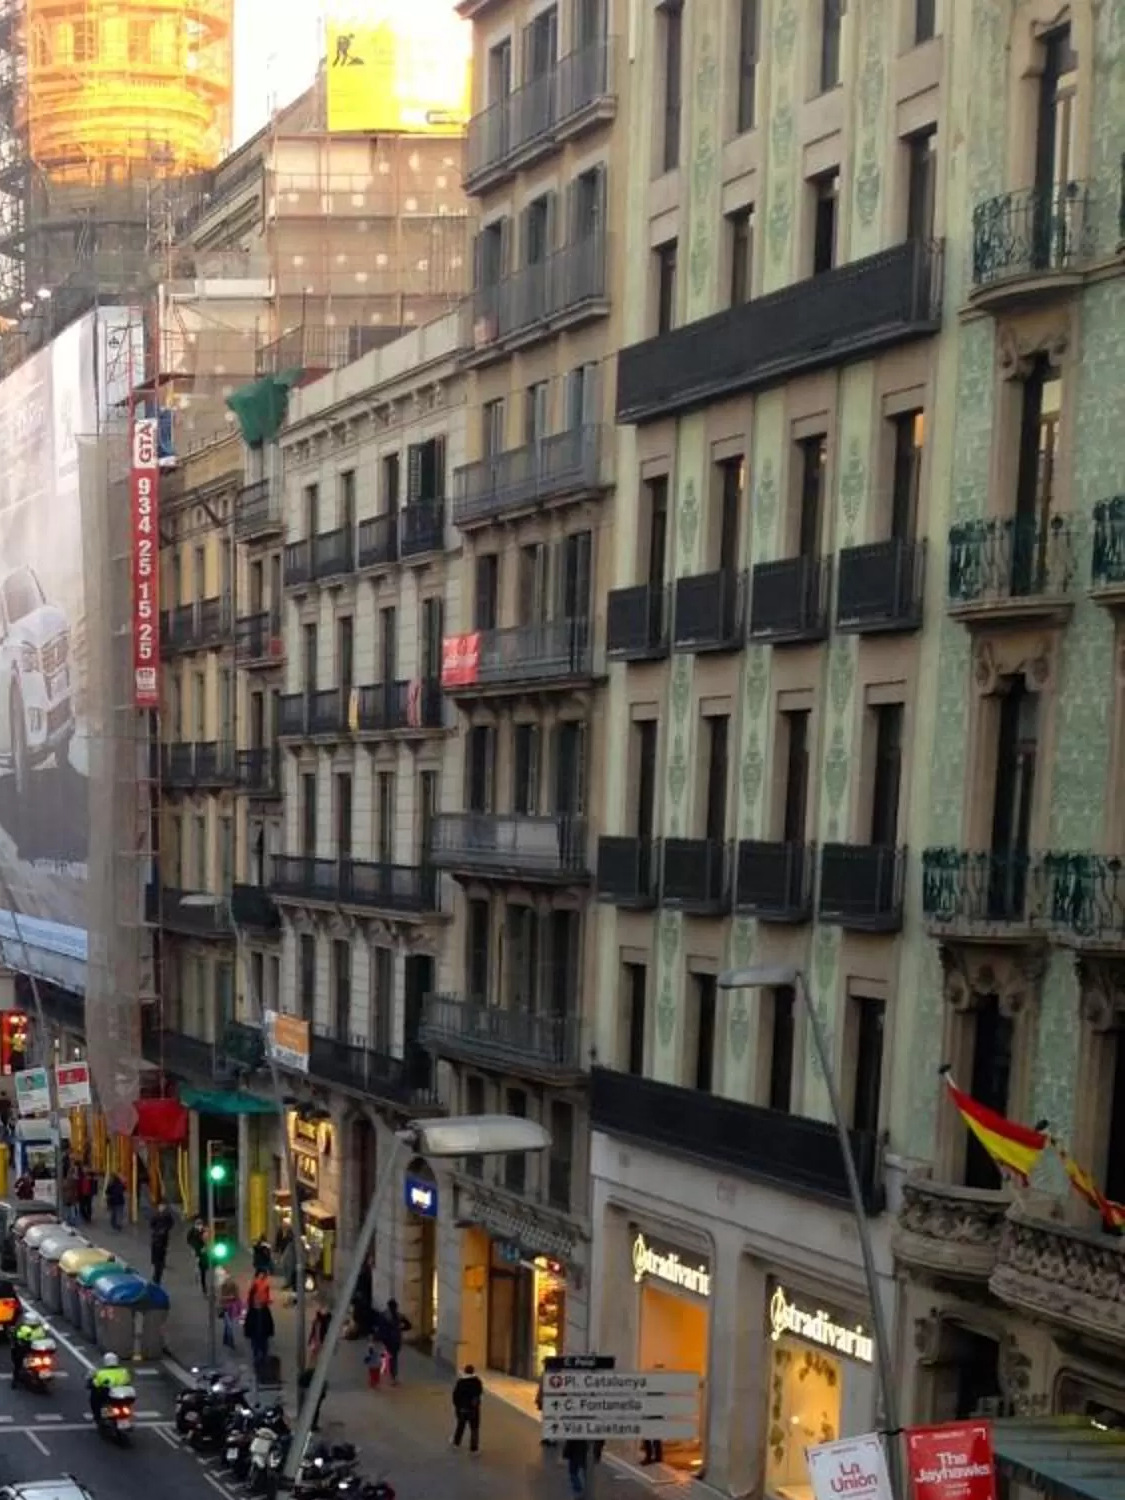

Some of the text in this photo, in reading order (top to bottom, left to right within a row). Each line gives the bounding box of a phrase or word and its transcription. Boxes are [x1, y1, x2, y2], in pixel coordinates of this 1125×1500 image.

[138, 422, 153, 464] GTA
[137, 476, 152, 535] 934
[138, 539, 152, 577] 25
[138, 583, 152, 619] 15
[138, 623, 152, 660] 25
[633, 1233, 711, 1296] Stradivari
[771, 1285, 874, 1363] Stradivariu
[584, 1375, 647, 1389] Catalunya
[839, 1461, 861, 1476] La
[915, 1463, 991, 1484] Jayhawks
[936, 1451, 968, 1466] The
